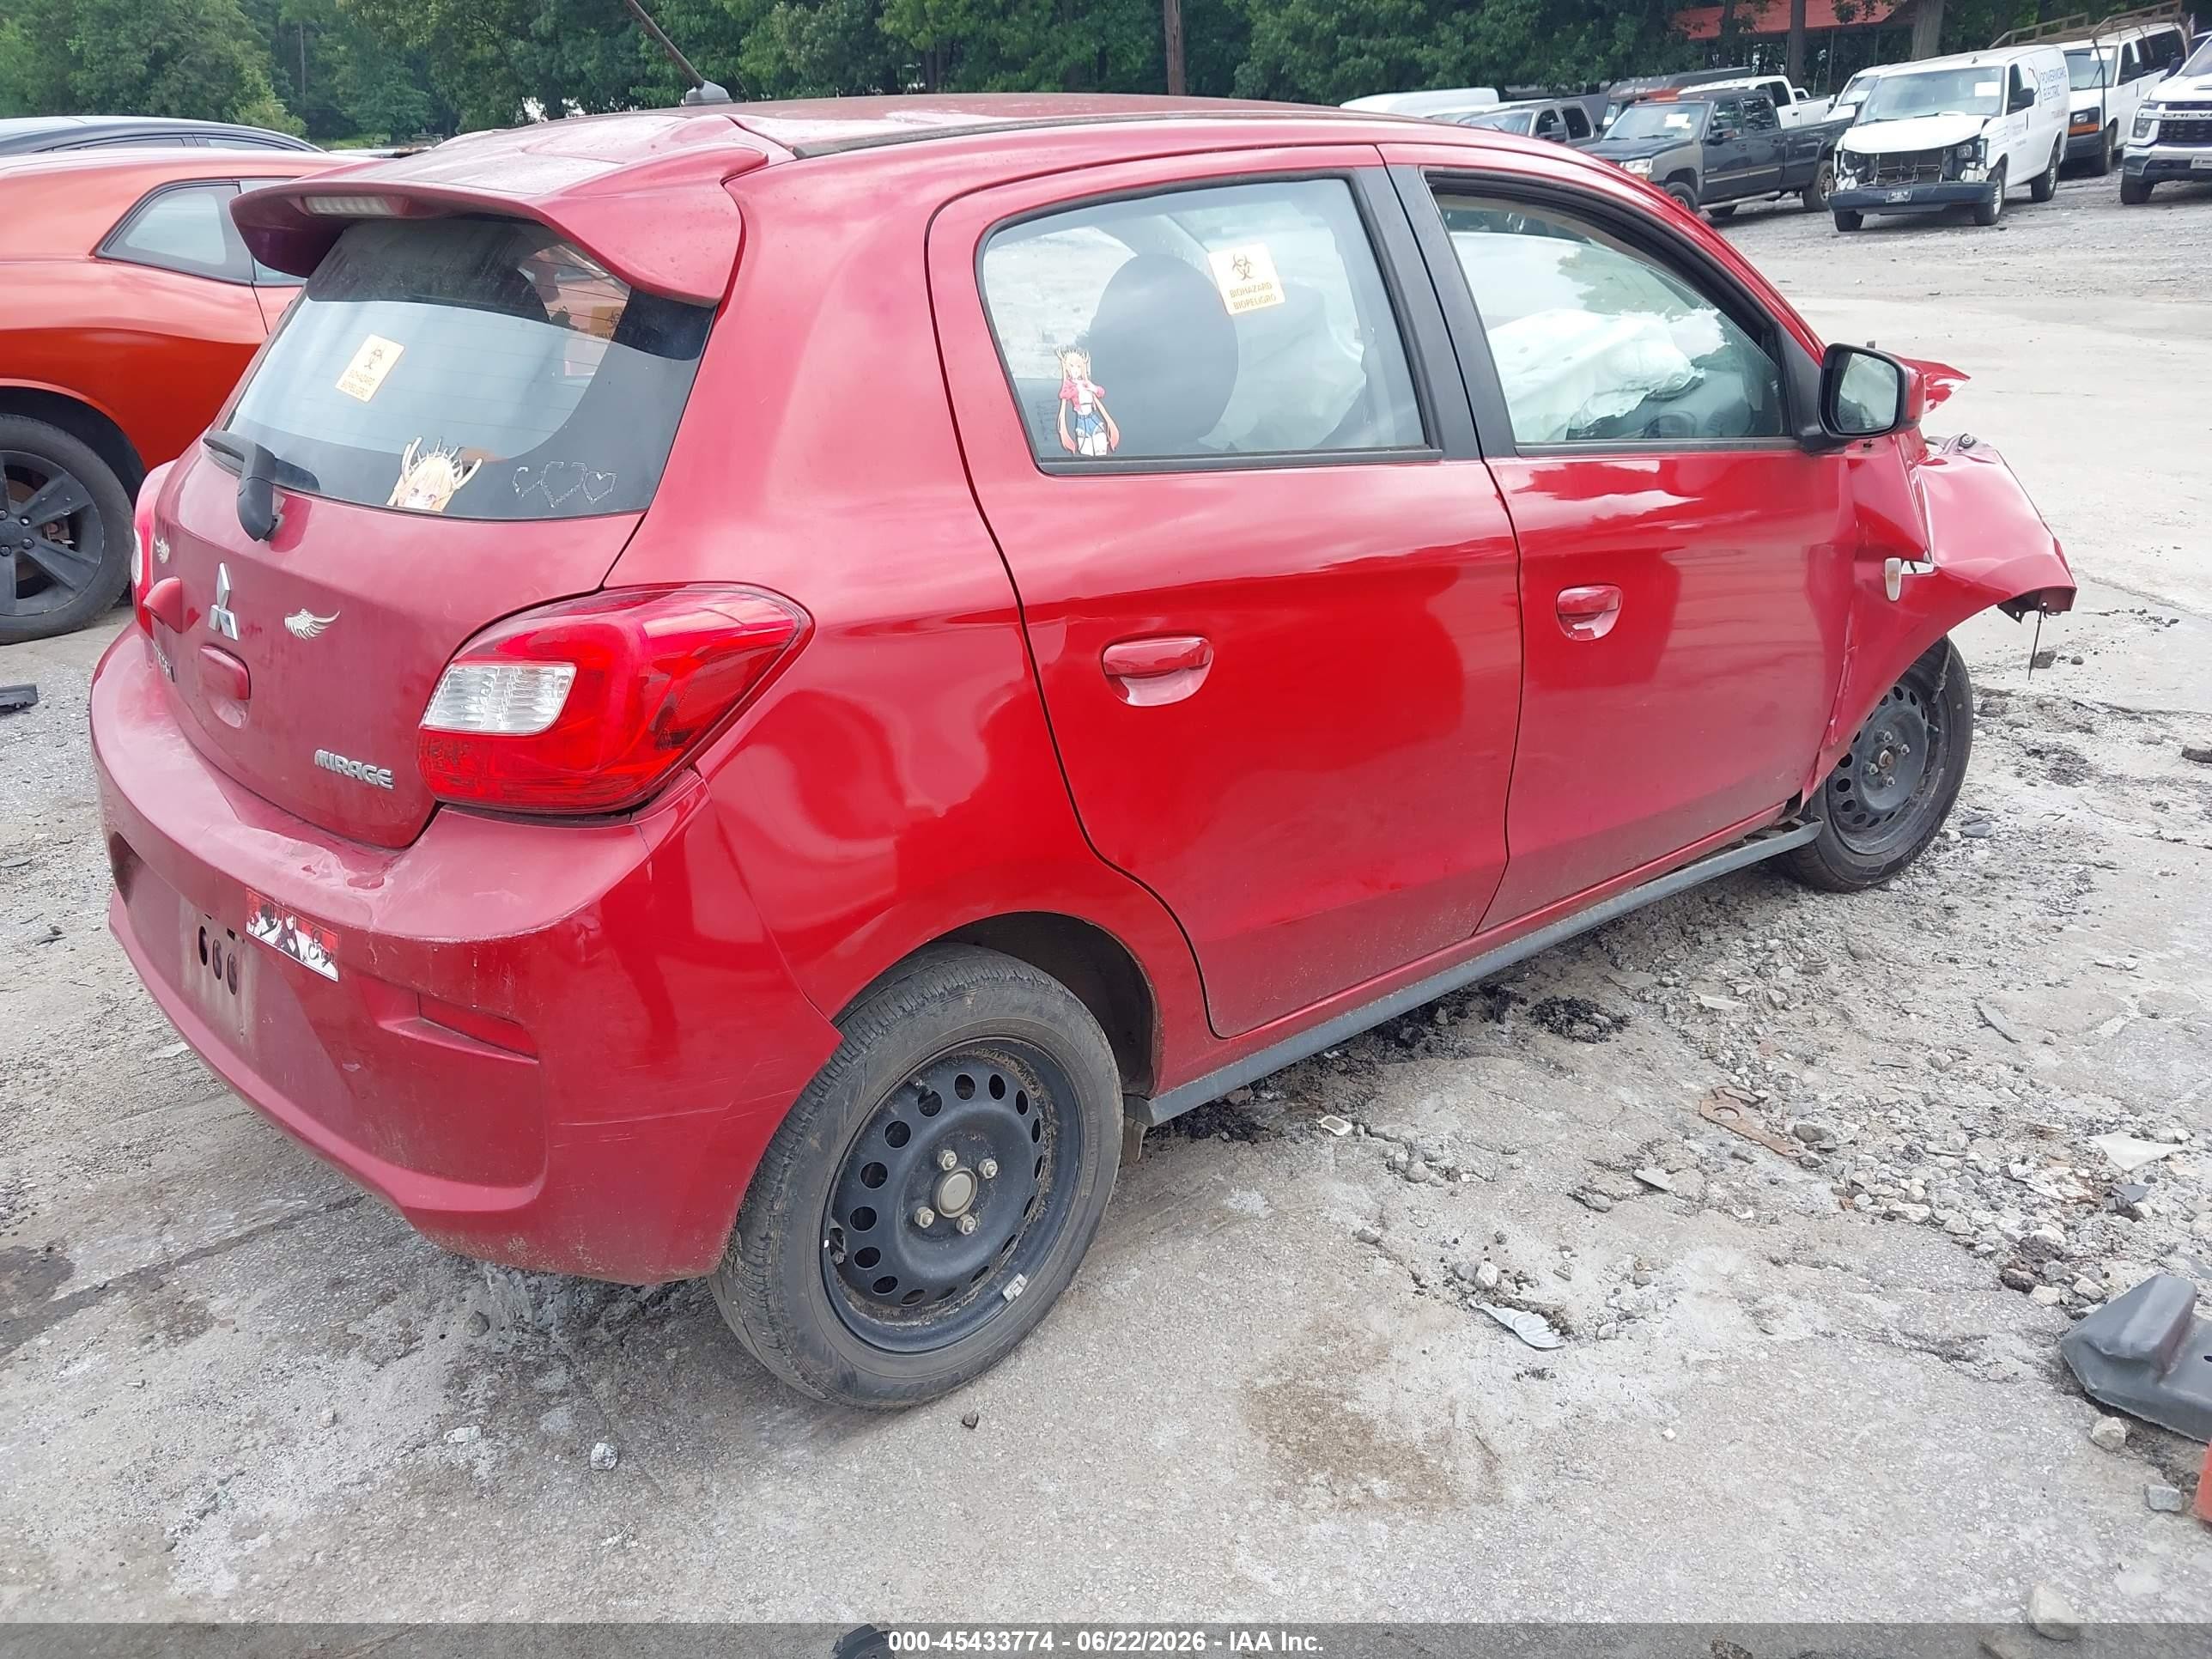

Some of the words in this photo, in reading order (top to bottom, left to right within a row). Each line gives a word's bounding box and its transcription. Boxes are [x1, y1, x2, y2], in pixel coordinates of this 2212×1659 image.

[1230, 283, 1273, 298] BIOHAZARD
[1234, 295, 1276, 309] BIOPELIGRO
[314, 749, 394, 789] MIRAGE
